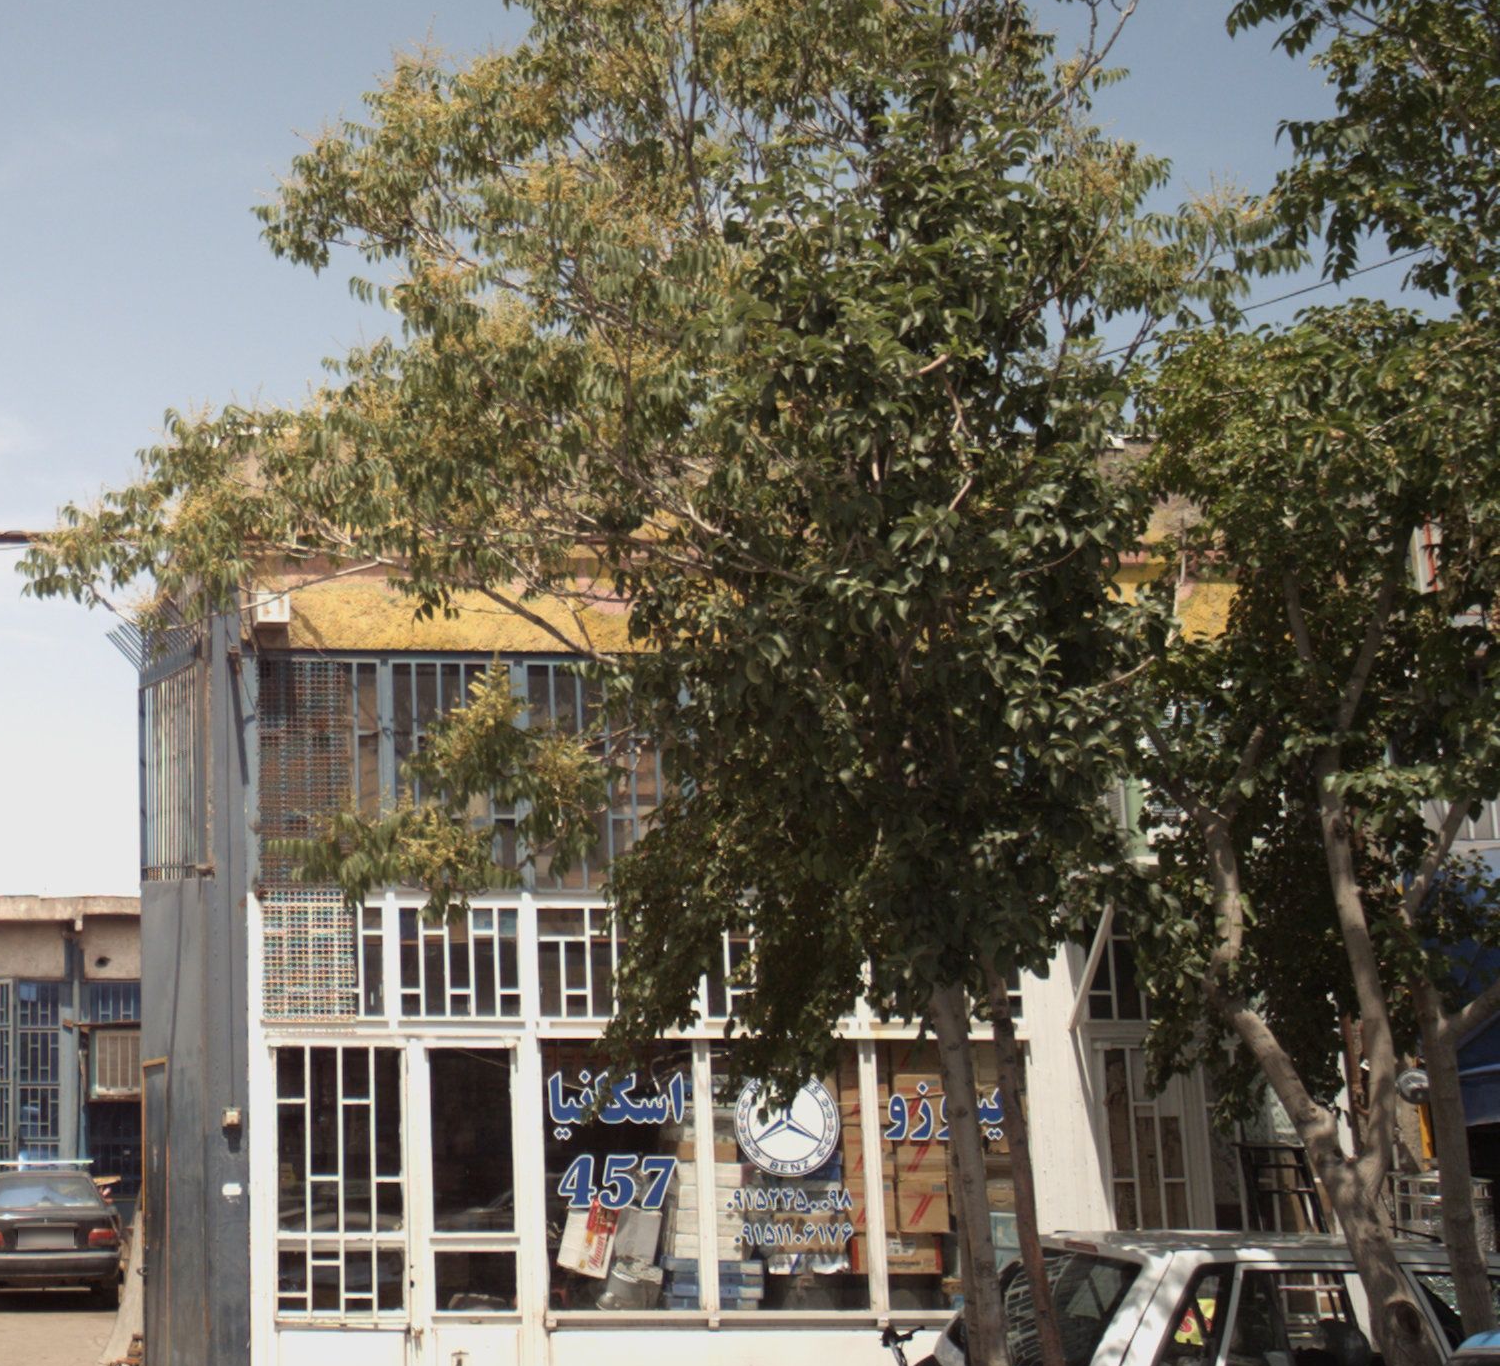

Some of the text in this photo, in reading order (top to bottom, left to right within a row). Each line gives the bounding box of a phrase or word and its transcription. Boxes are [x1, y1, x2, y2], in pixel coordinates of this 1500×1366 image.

[769, 1160, 810, 1173] BENZ
[557, 1154, 679, 1210] 457
[734, 1221, 854, 1247] ۰۹۱۵۱۱۰۶۱۷۶
